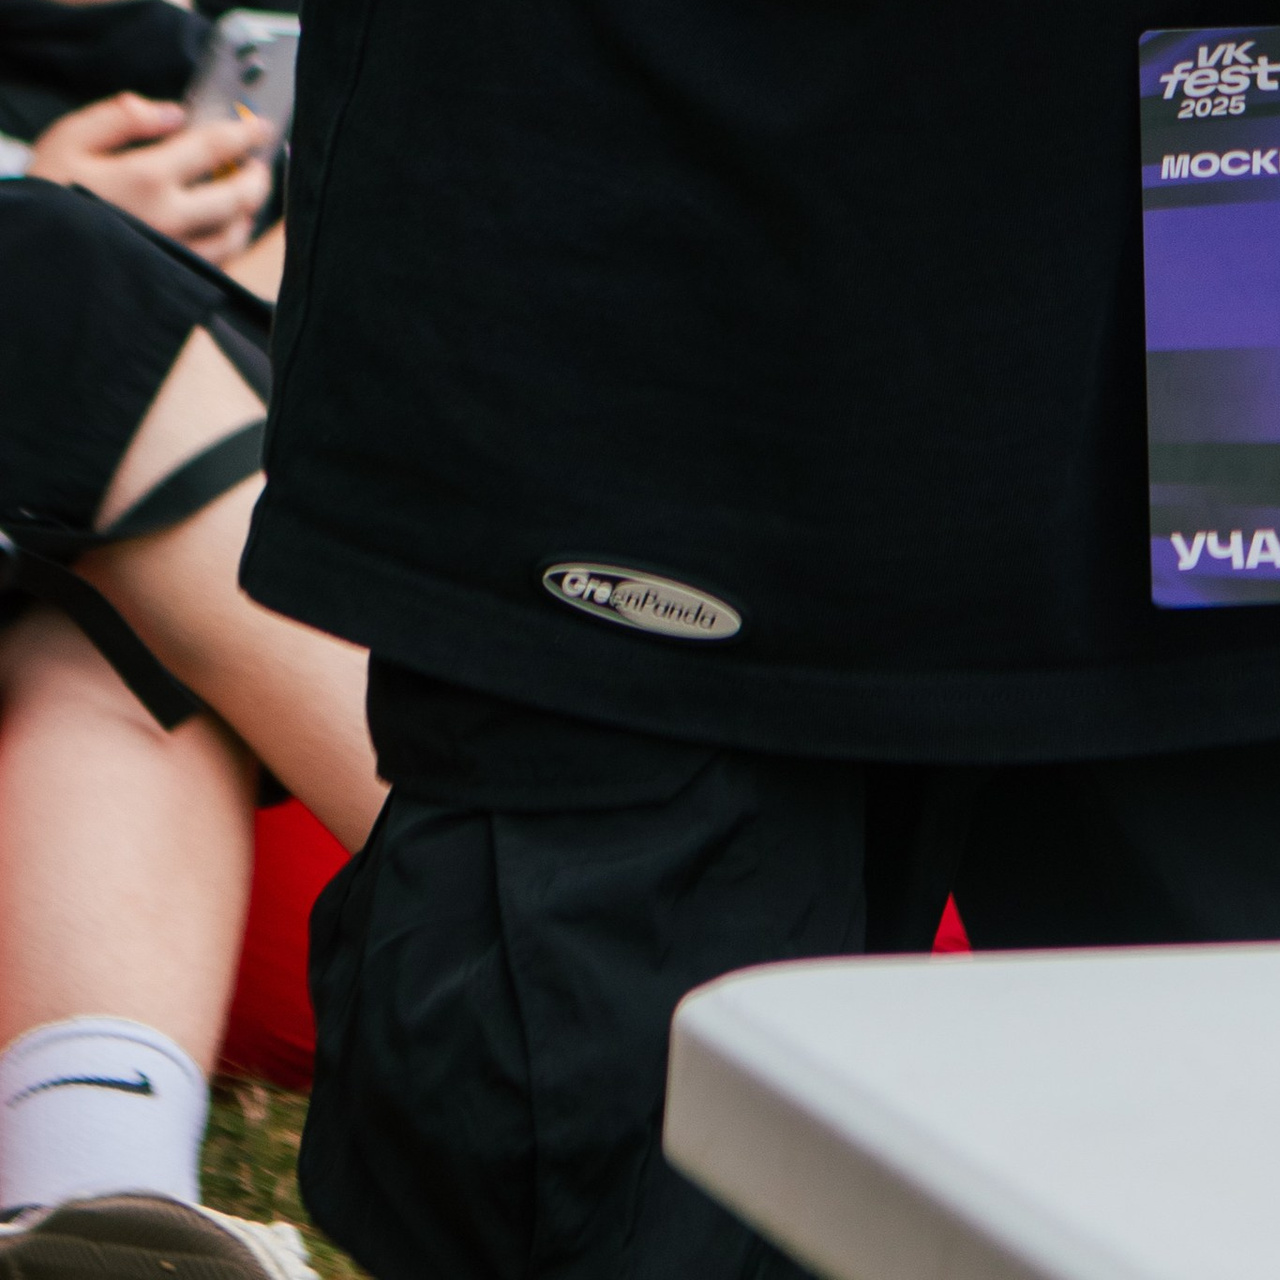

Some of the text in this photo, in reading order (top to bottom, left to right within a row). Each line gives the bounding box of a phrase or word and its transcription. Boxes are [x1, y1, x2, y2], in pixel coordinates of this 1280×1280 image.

[1198, 40, 1256, 68] VK
[1177, 94, 1246, 119] 2025
[561, 569, 717, 630] GreenPanda
